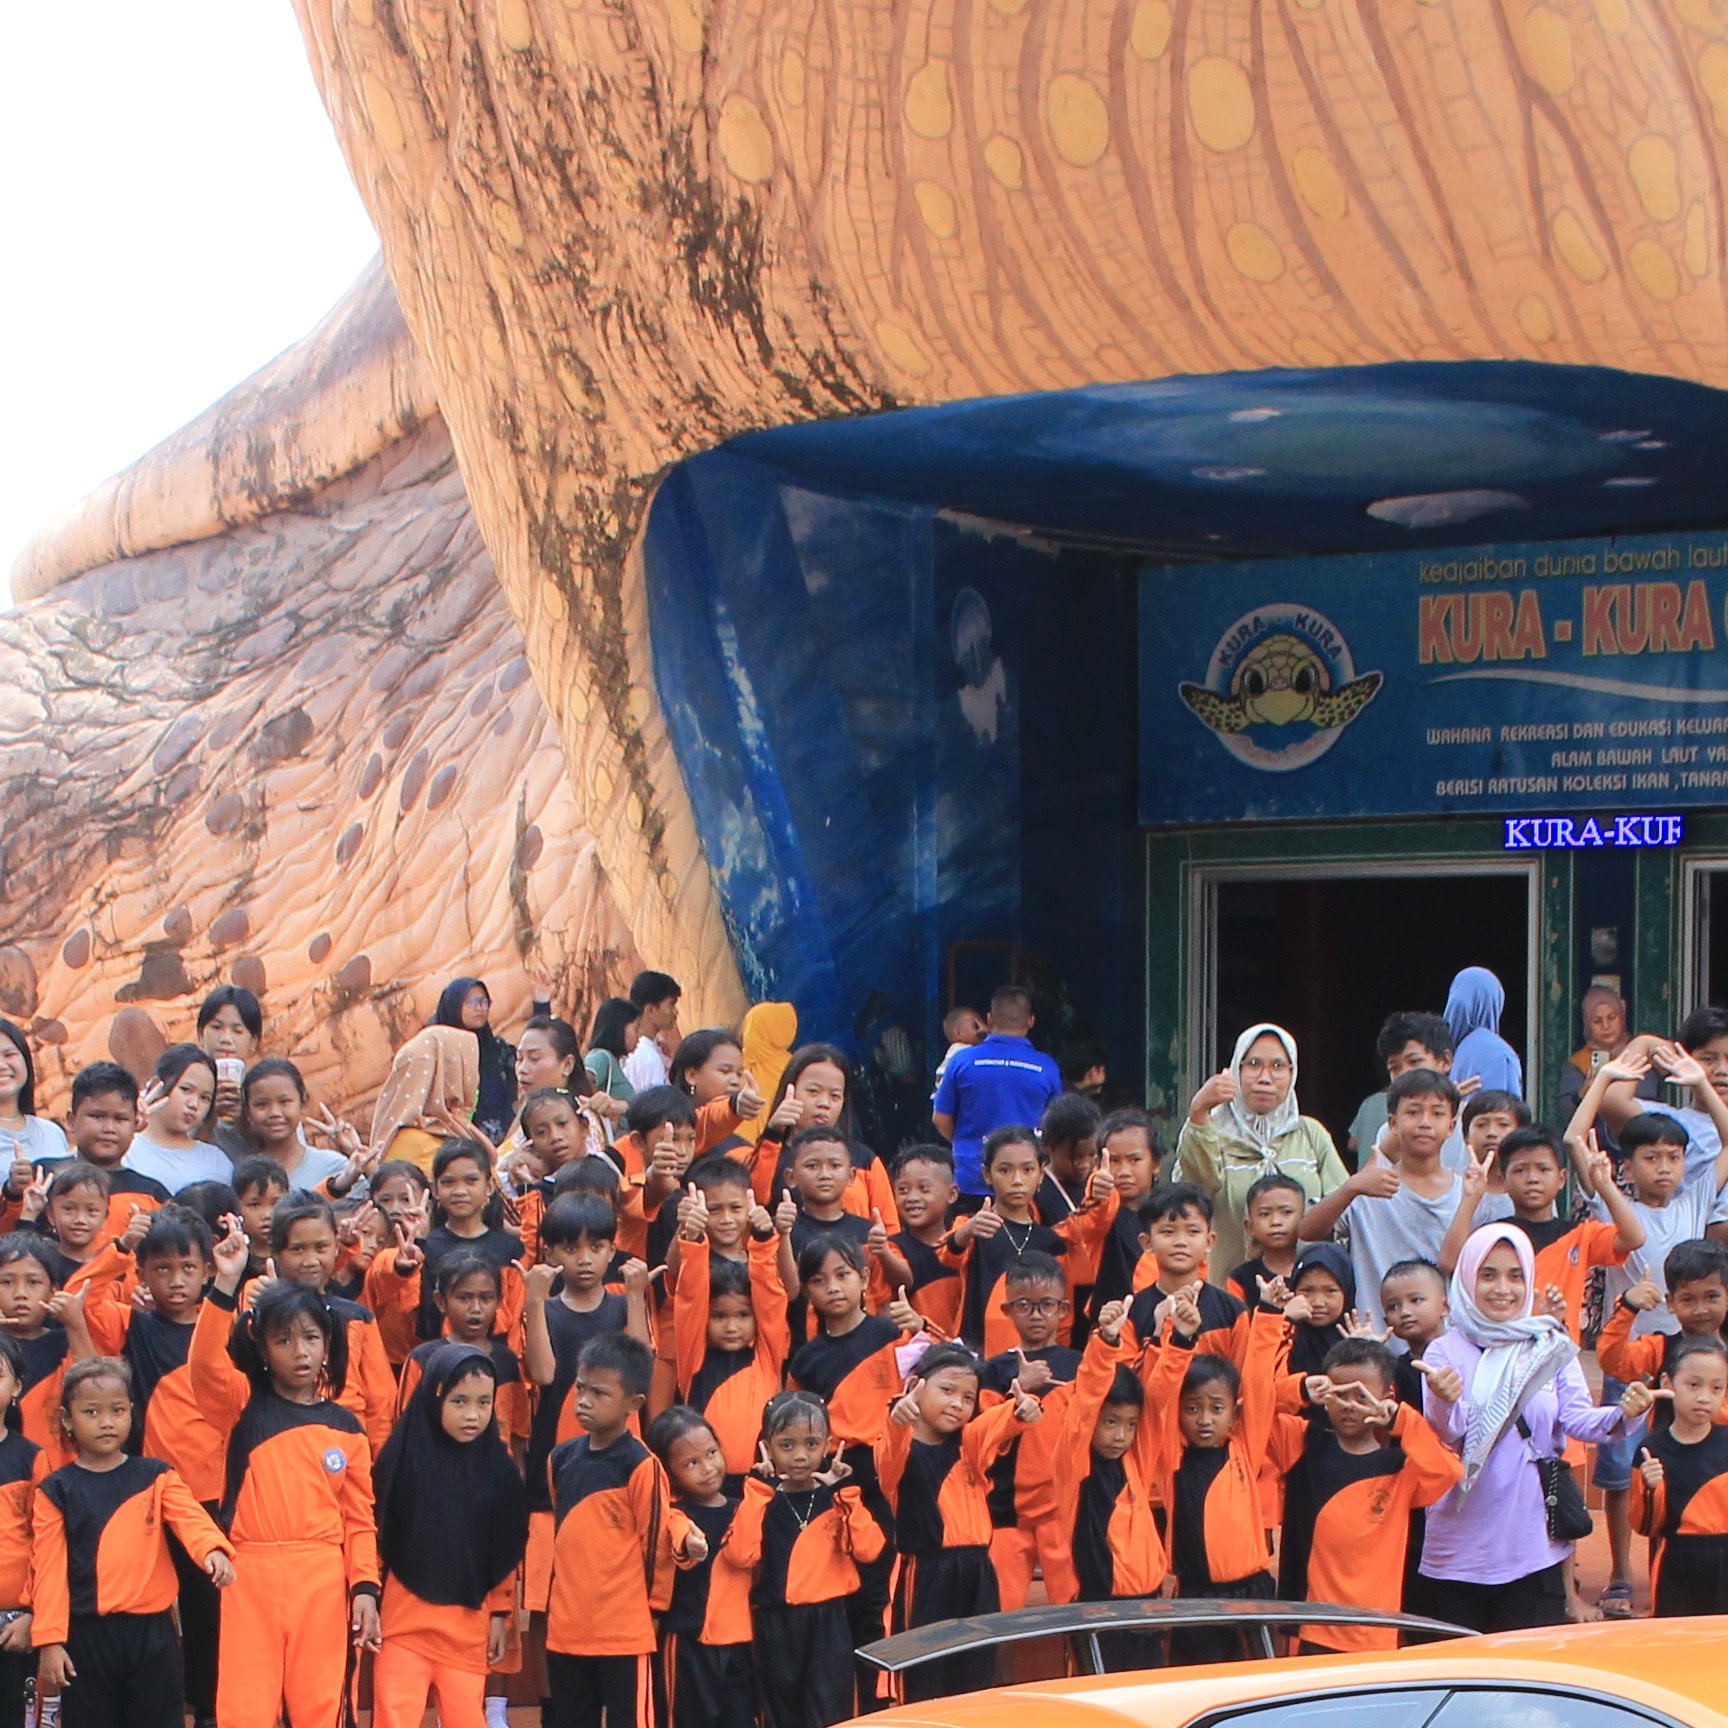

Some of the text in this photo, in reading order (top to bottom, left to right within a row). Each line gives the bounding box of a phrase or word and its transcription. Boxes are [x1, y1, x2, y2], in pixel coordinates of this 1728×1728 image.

[1420, 556, 1527, 586] keajaiban
[1535, 552, 1597, 578] dunia
[1604, 544, 1680, 574] bawah
[1218, 615, 1266, 667] KURA
[1293, 612, 1343, 662] KURA
[1419, 589, 1548, 665] KURA
[1583, 580, 1716, 657] KURA
[1427, 727, 1492, 745] WAHANA
[1500, 723, 1569, 742] REKREASI
[1573, 721, 1605, 739] DAN
[1609, 719, 1671, 738] EDUKASI
[1551, 751, 1593, 769] ALAM
[1597, 748, 1652, 766] BAWAH
[1662, 745, 1699, 763] LAUT
[1436, 779, 1483, 796] BERISI
[1488, 776, 1558, 795] RATUSAN
[1563, 774, 1627, 793] KOLEKSI
[1632, 772, 1670, 790] IKAN
